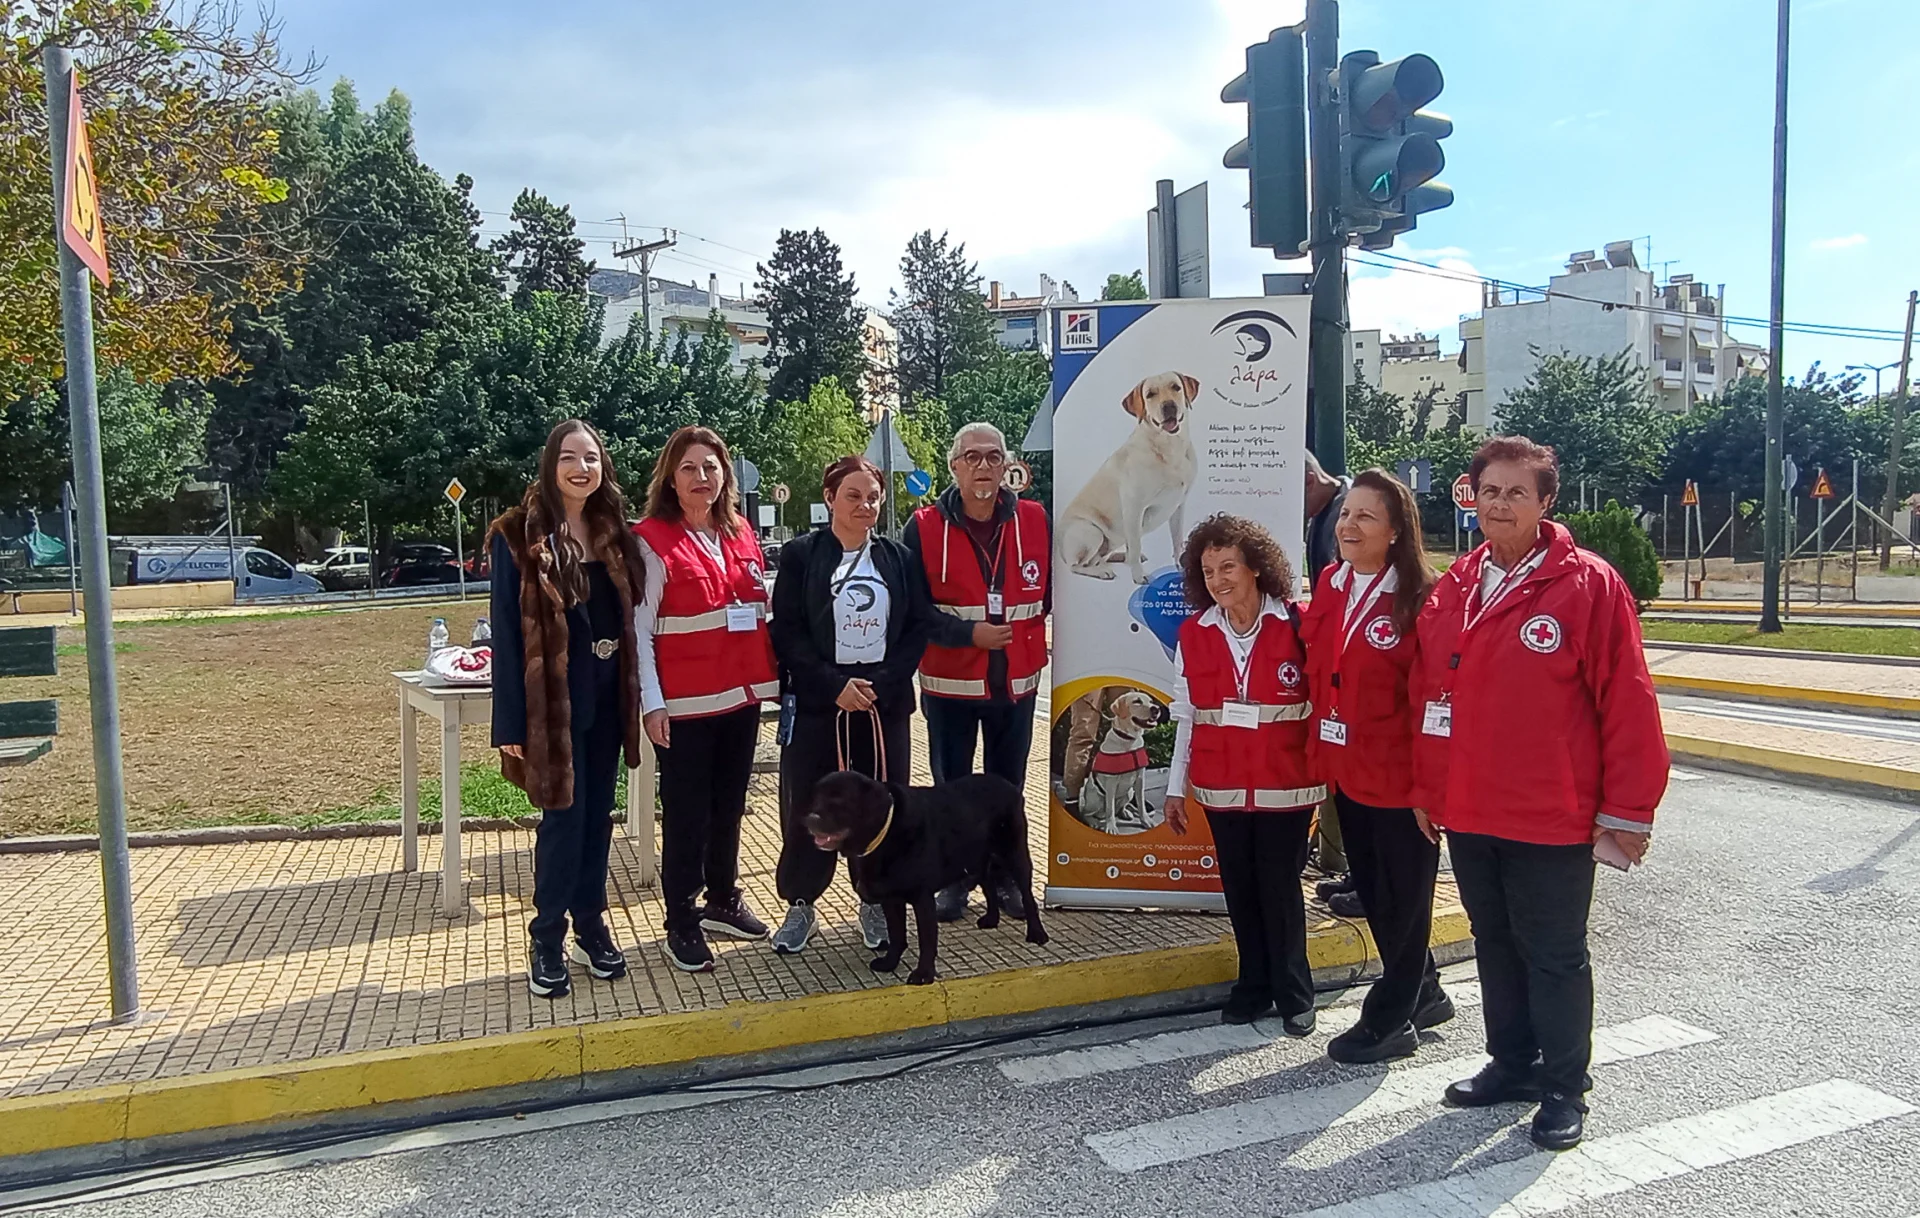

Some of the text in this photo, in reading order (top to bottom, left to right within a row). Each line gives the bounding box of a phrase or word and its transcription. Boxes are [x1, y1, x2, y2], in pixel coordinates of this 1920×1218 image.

[1066, 333, 1093, 345] Hill's
[1230, 364, 1278, 393] λάρα
[1456, 484, 1475, 502] STO
[1160, 608, 1183, 616] Alpha
[843, 613, 880, 637] λάρα
